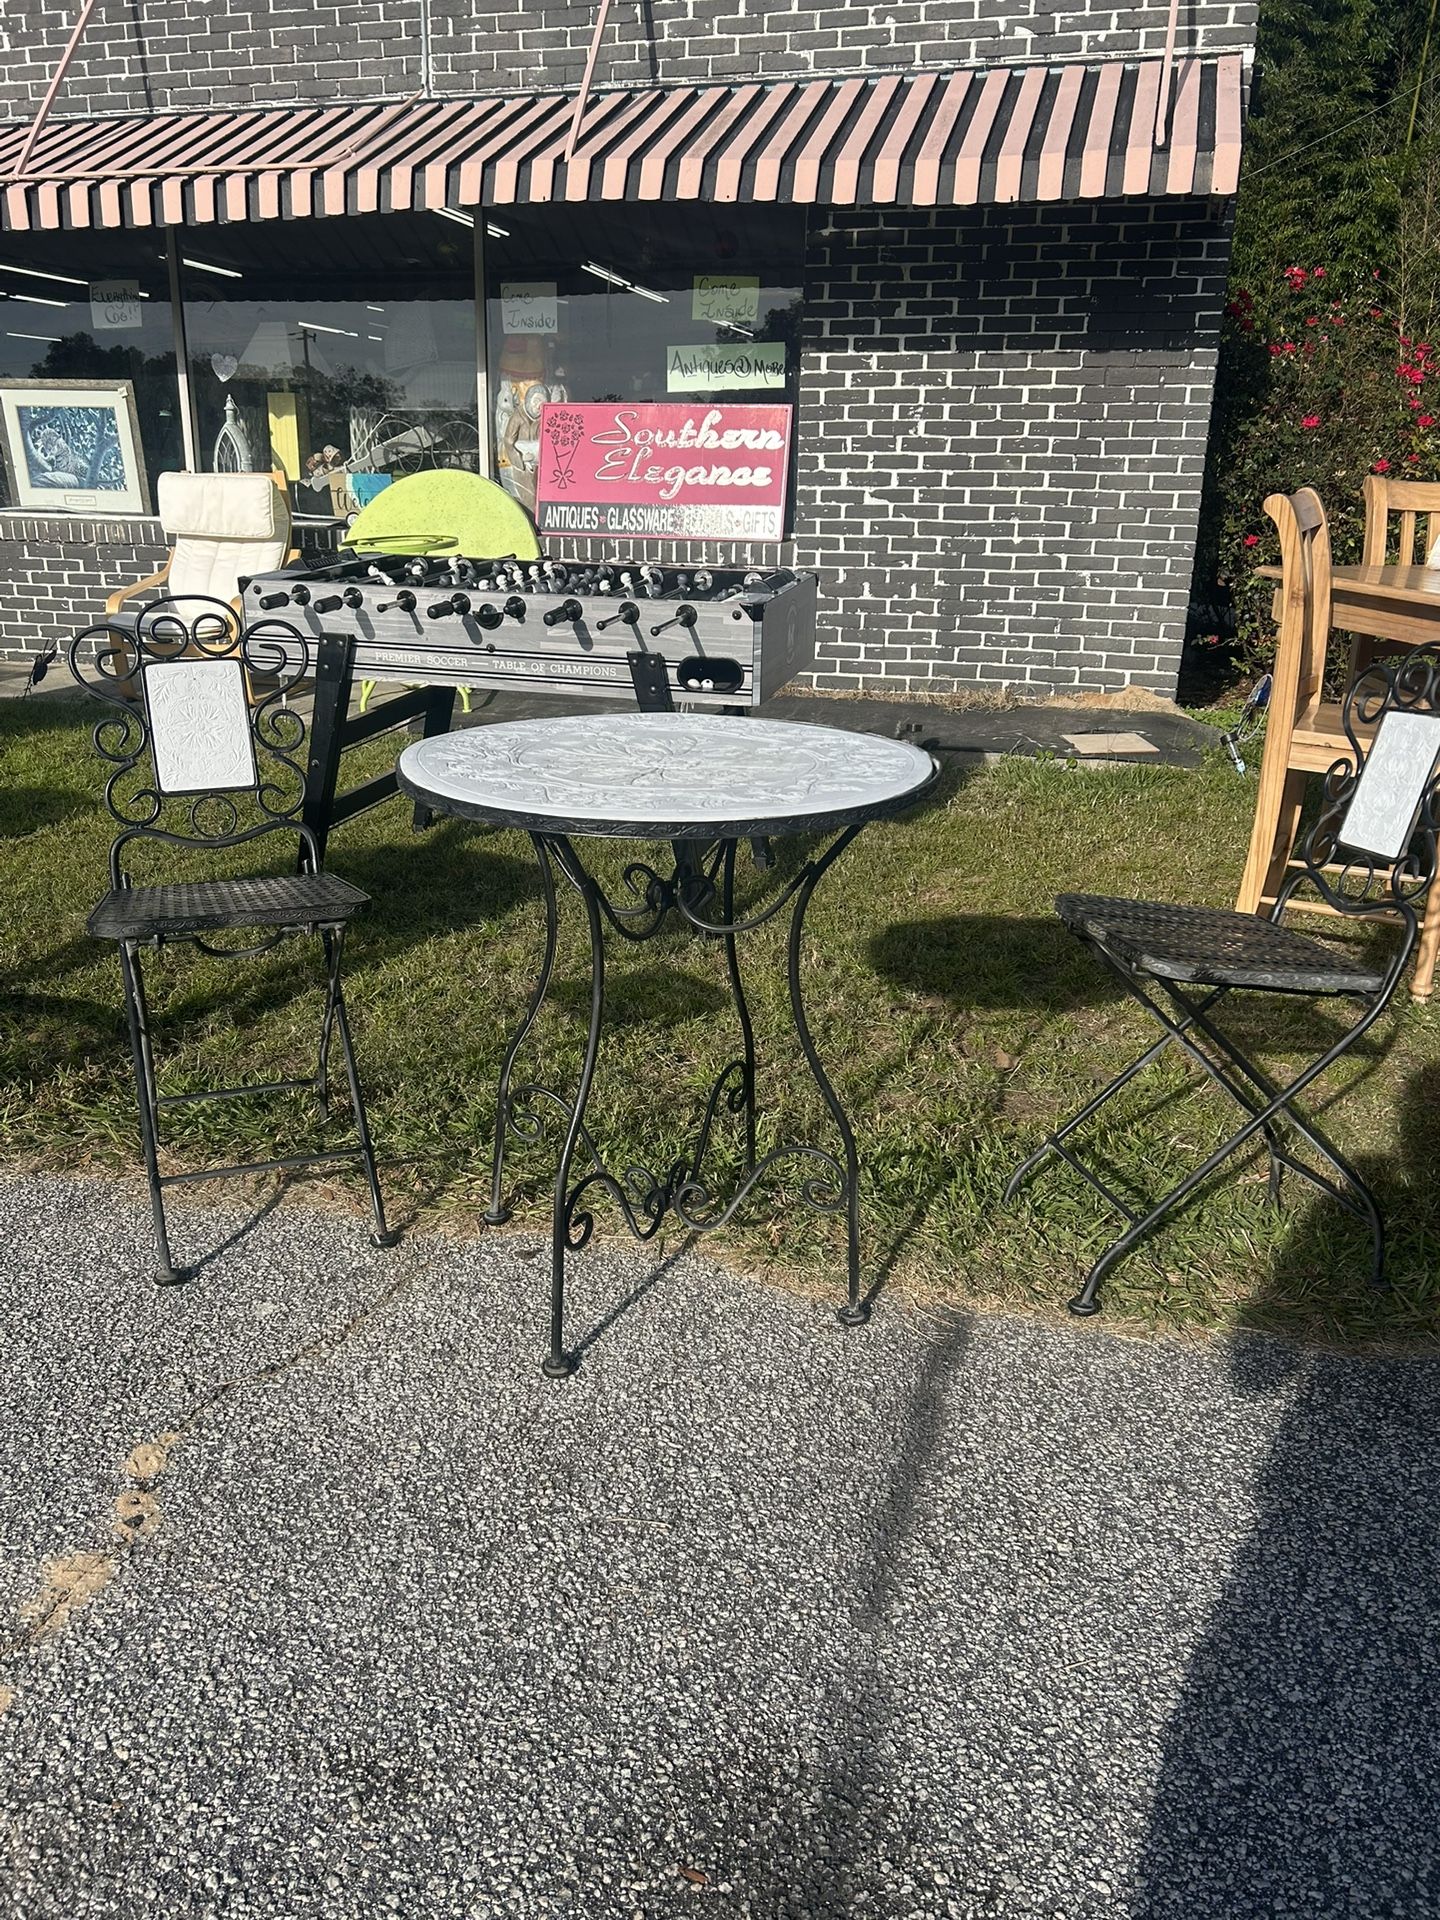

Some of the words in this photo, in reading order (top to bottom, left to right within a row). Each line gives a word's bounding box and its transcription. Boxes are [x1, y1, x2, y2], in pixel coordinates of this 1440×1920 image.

[699, 277, 741, 301] Come
[506, 309, 556, 329] Inside
[590, 410, 785, 450] Southern
[594, 446, 773, 500] Elegance
[544, 505, 599, 530] ANTIQUES
[607, 507, 675, 532] GLASSWARE
[742, 510, 776, 534] GIFTS
[375, 651, 421, 664] PREMIER
[426, 655, 468, 667] SOCCER
[492, 659, 526, 671] TABLE
[530, 662, 546, 675] OF
[549, 663, 617, 677] CHAMPIONS
